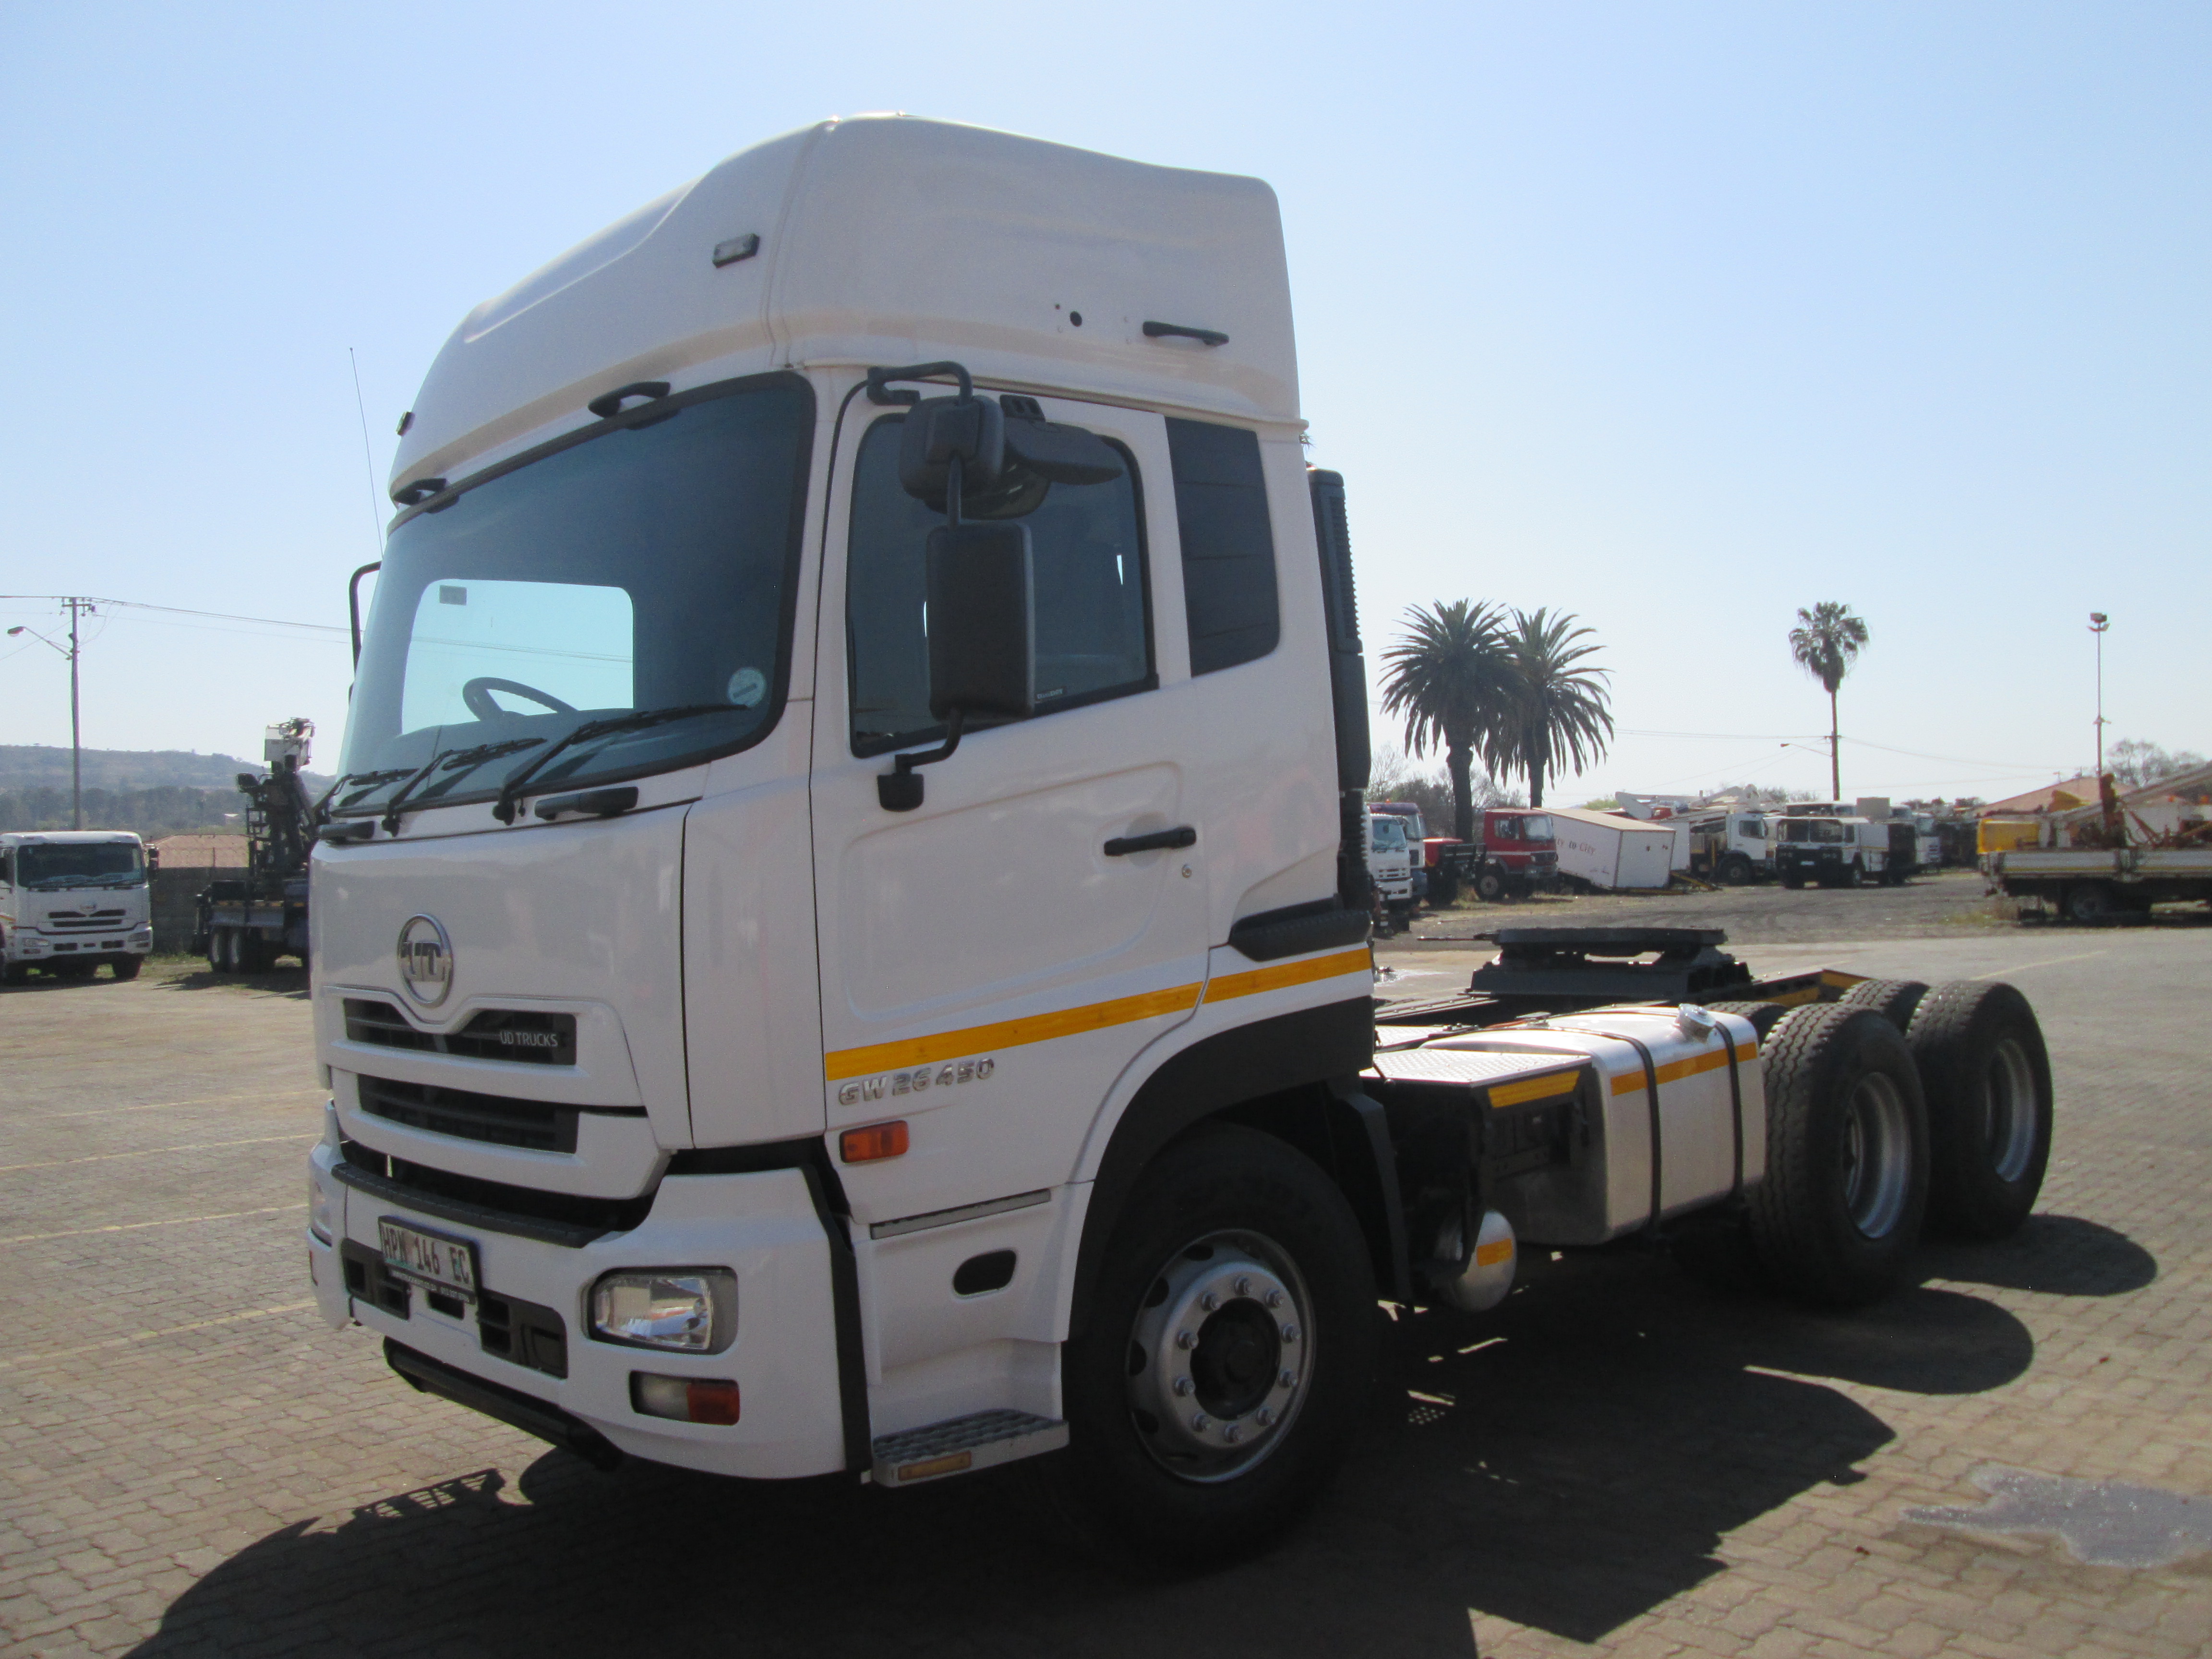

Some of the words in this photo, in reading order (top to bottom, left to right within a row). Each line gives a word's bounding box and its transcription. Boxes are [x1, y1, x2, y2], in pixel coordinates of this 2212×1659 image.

[499, 1031, 514, 1045] UD
[516, 1032, 558, 1047] TRUCKS
[839, 1076, 886, 1105] GW
[892, 1067, 931, 1096] 26
[936, 1058, 994, 1086] 450
[414, 1236, 440, 1274] 146
[449, 1246, 469, 1284] EC
